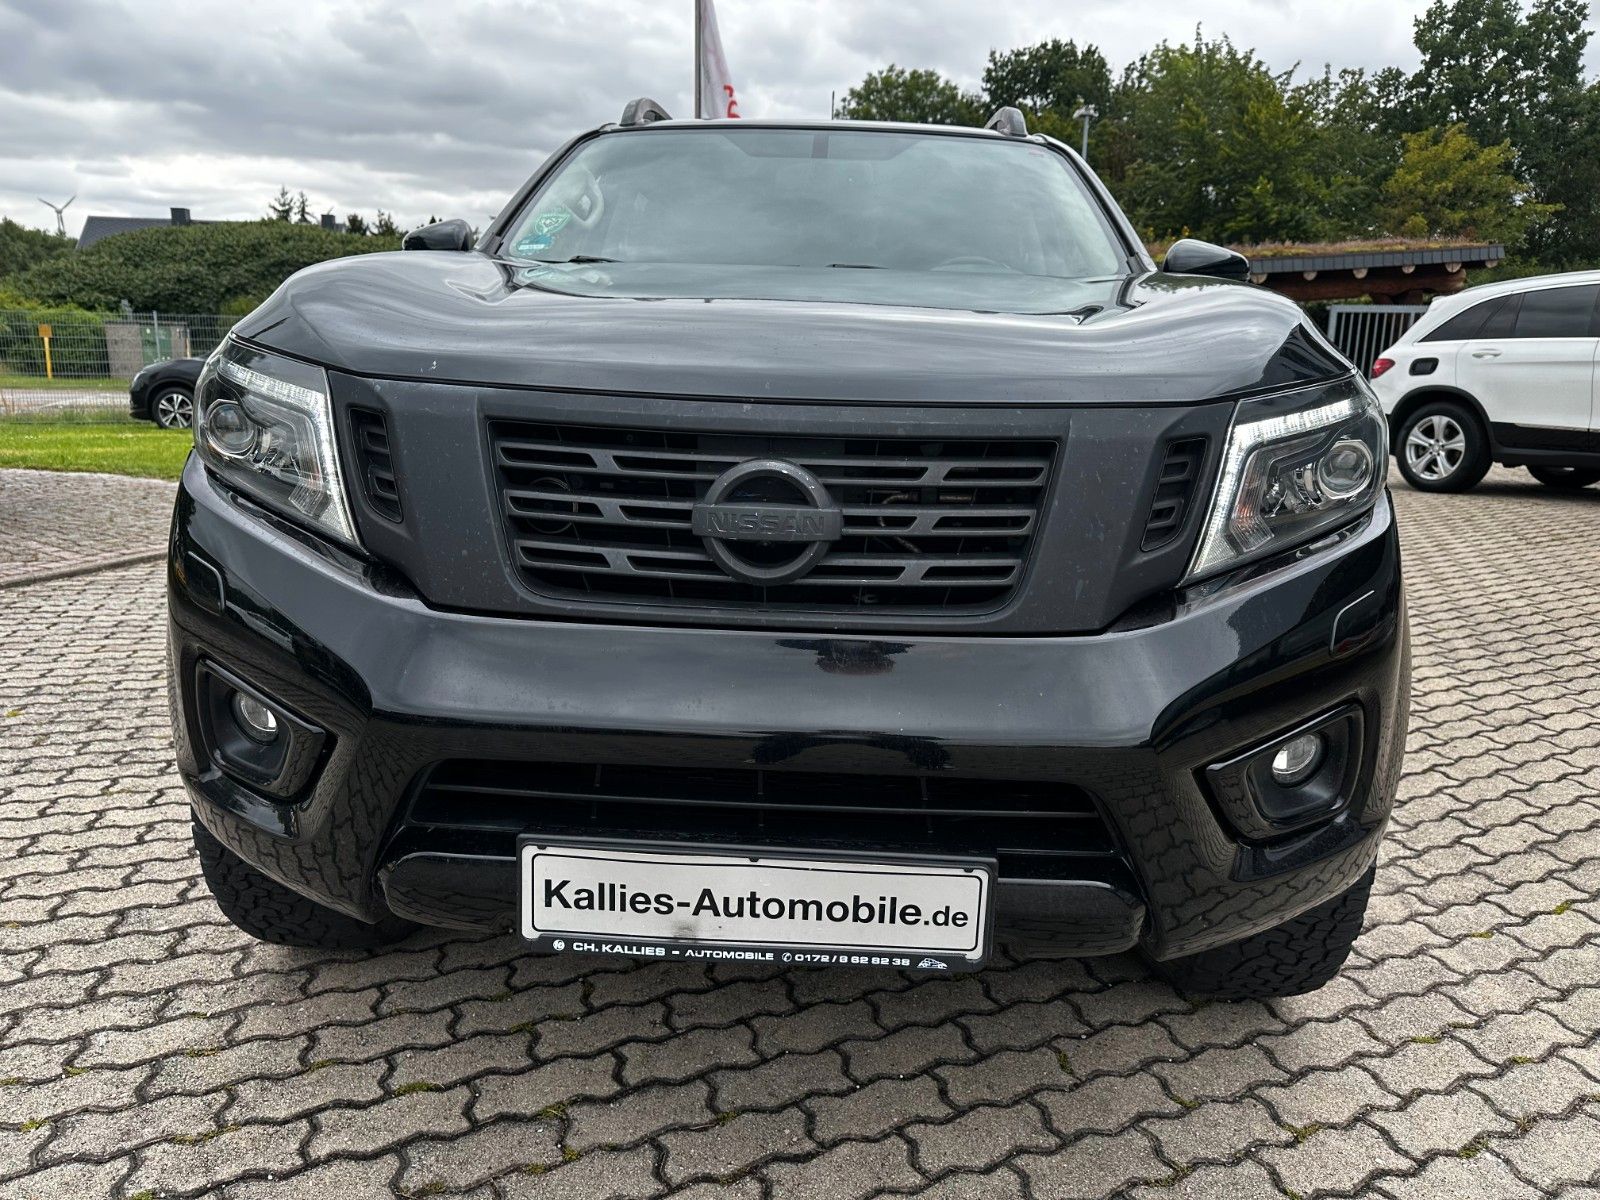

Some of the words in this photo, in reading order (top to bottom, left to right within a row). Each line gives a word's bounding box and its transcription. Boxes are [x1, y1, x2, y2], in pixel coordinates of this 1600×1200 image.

[706, 512, 825, 536] NISSAN
[543, 879, 969, 928] Kallies-Automobile.de
[572, 942, 599, 953] CH.
[602, 944, 666, 956] KALLIES
[685, 949, 774, 961] AUTOMOBILE
